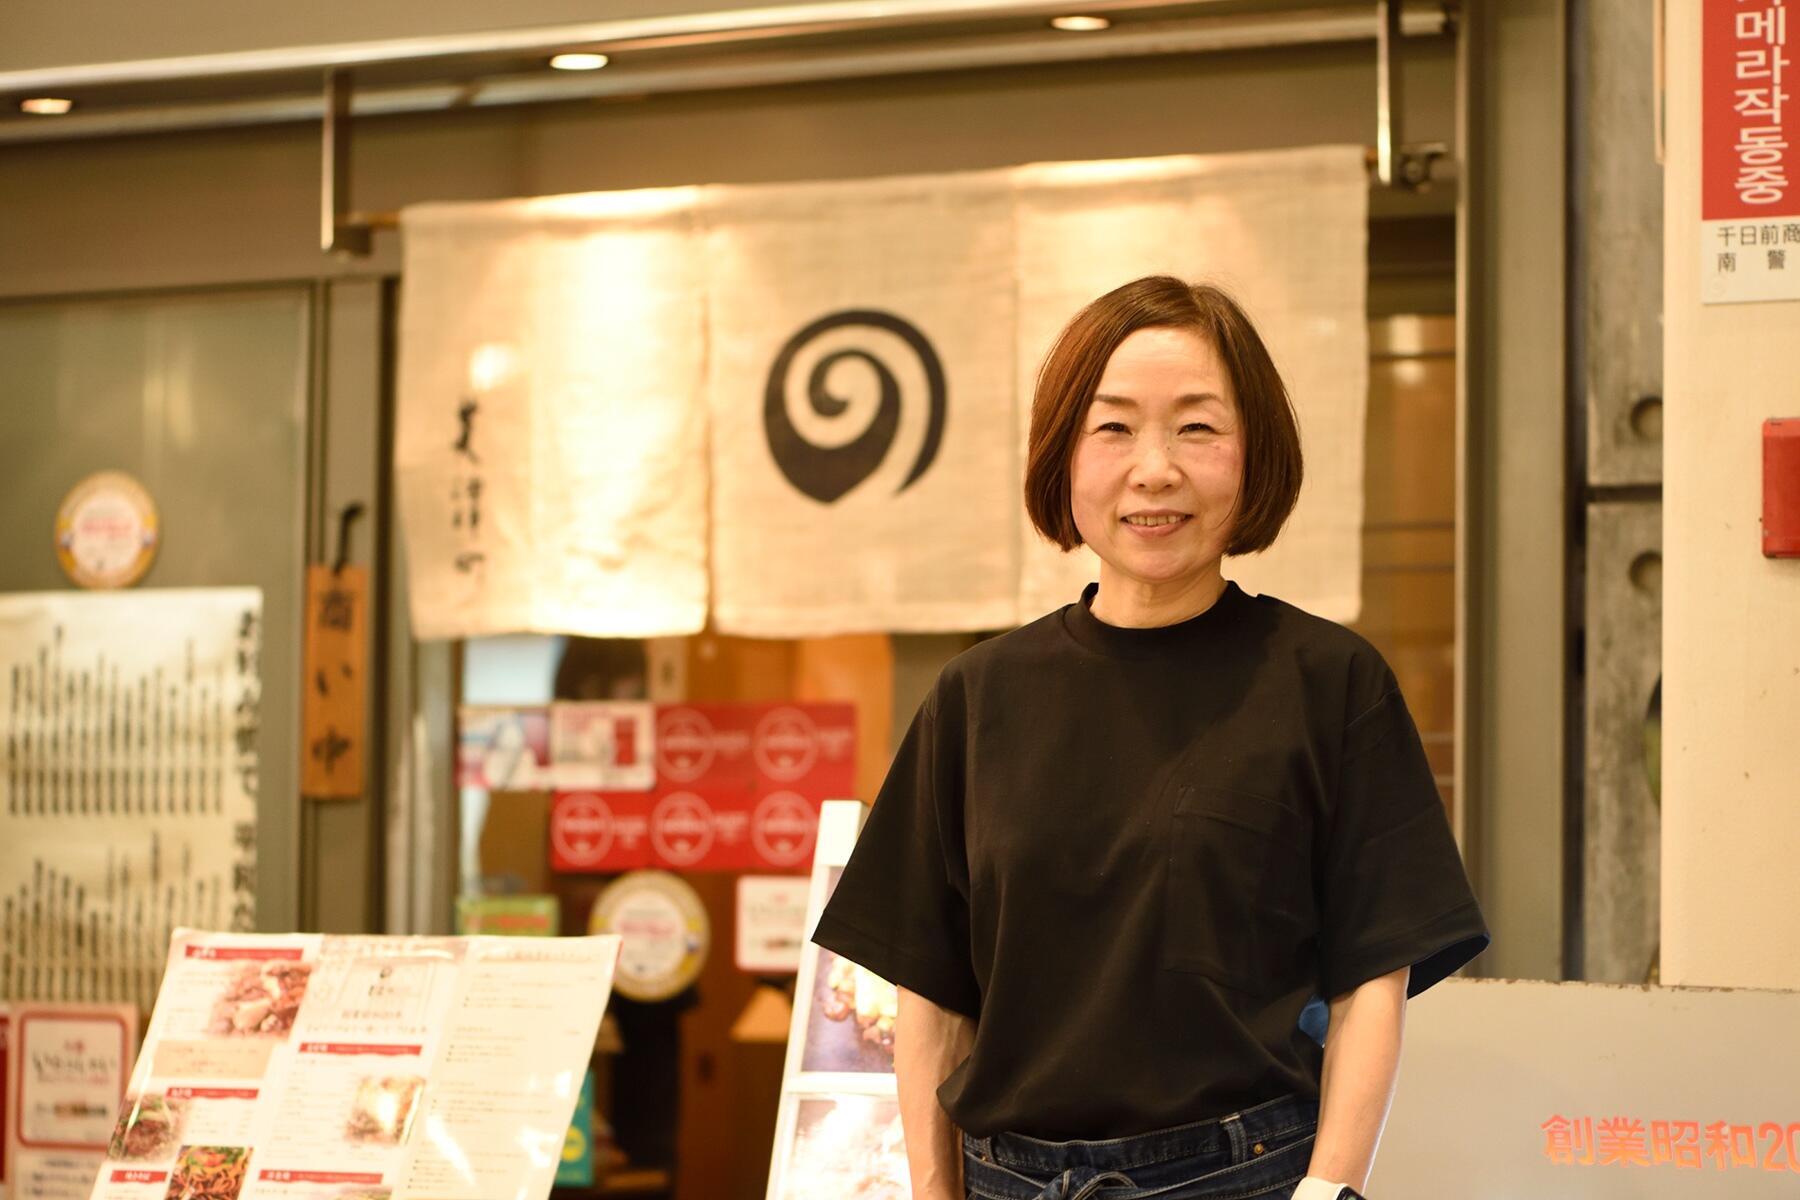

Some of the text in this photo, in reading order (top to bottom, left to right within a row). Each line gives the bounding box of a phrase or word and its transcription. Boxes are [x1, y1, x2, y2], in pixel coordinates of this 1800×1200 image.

[1733, 0, 1790, 204] 메라작동중
[1717, 223, 1800, 247] 千日前商
